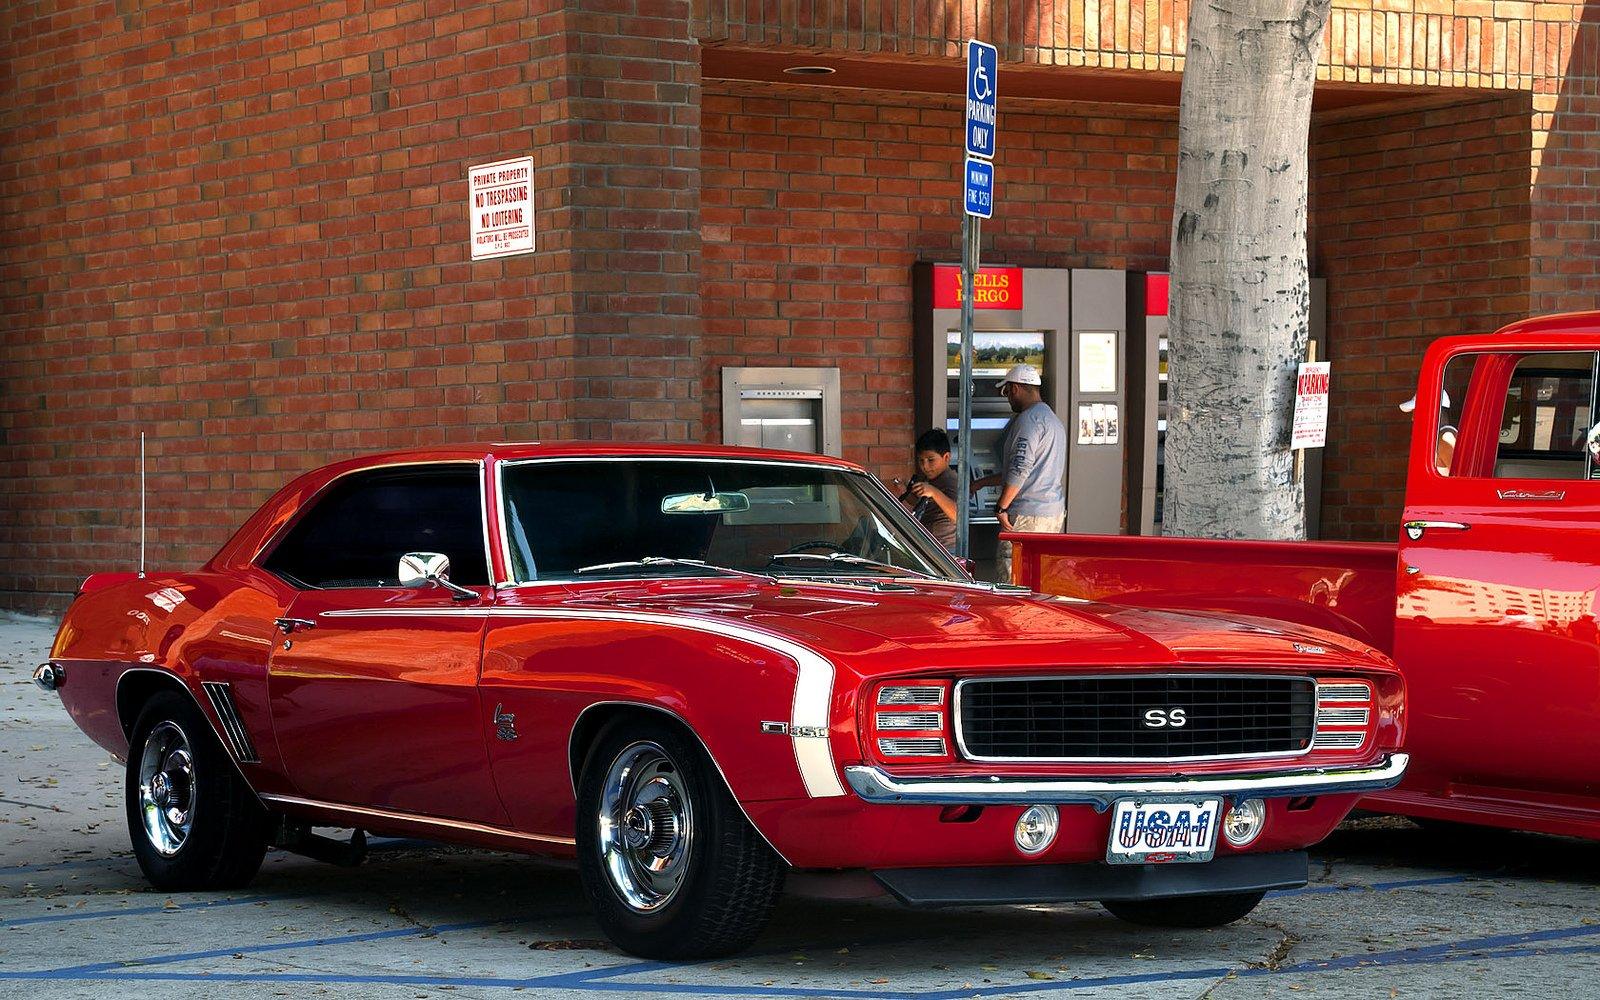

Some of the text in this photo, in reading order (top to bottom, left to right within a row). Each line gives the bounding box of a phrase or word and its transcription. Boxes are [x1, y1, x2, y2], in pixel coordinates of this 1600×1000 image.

[968, 98, 995, 126] PARKING
[972, 125, 989, 149] ONLY
[474, 167, 528, 186] PRIVATE PROPERTY
[475, 185, 528, 208] NO TRESPASSING
[968, 188, 978, 204] FINE
[481, 207, 523, 228] NO LOITERING
[1297, 372, 1329, 397] NO PARKING
[1144, 709, 1187, 727] SS
